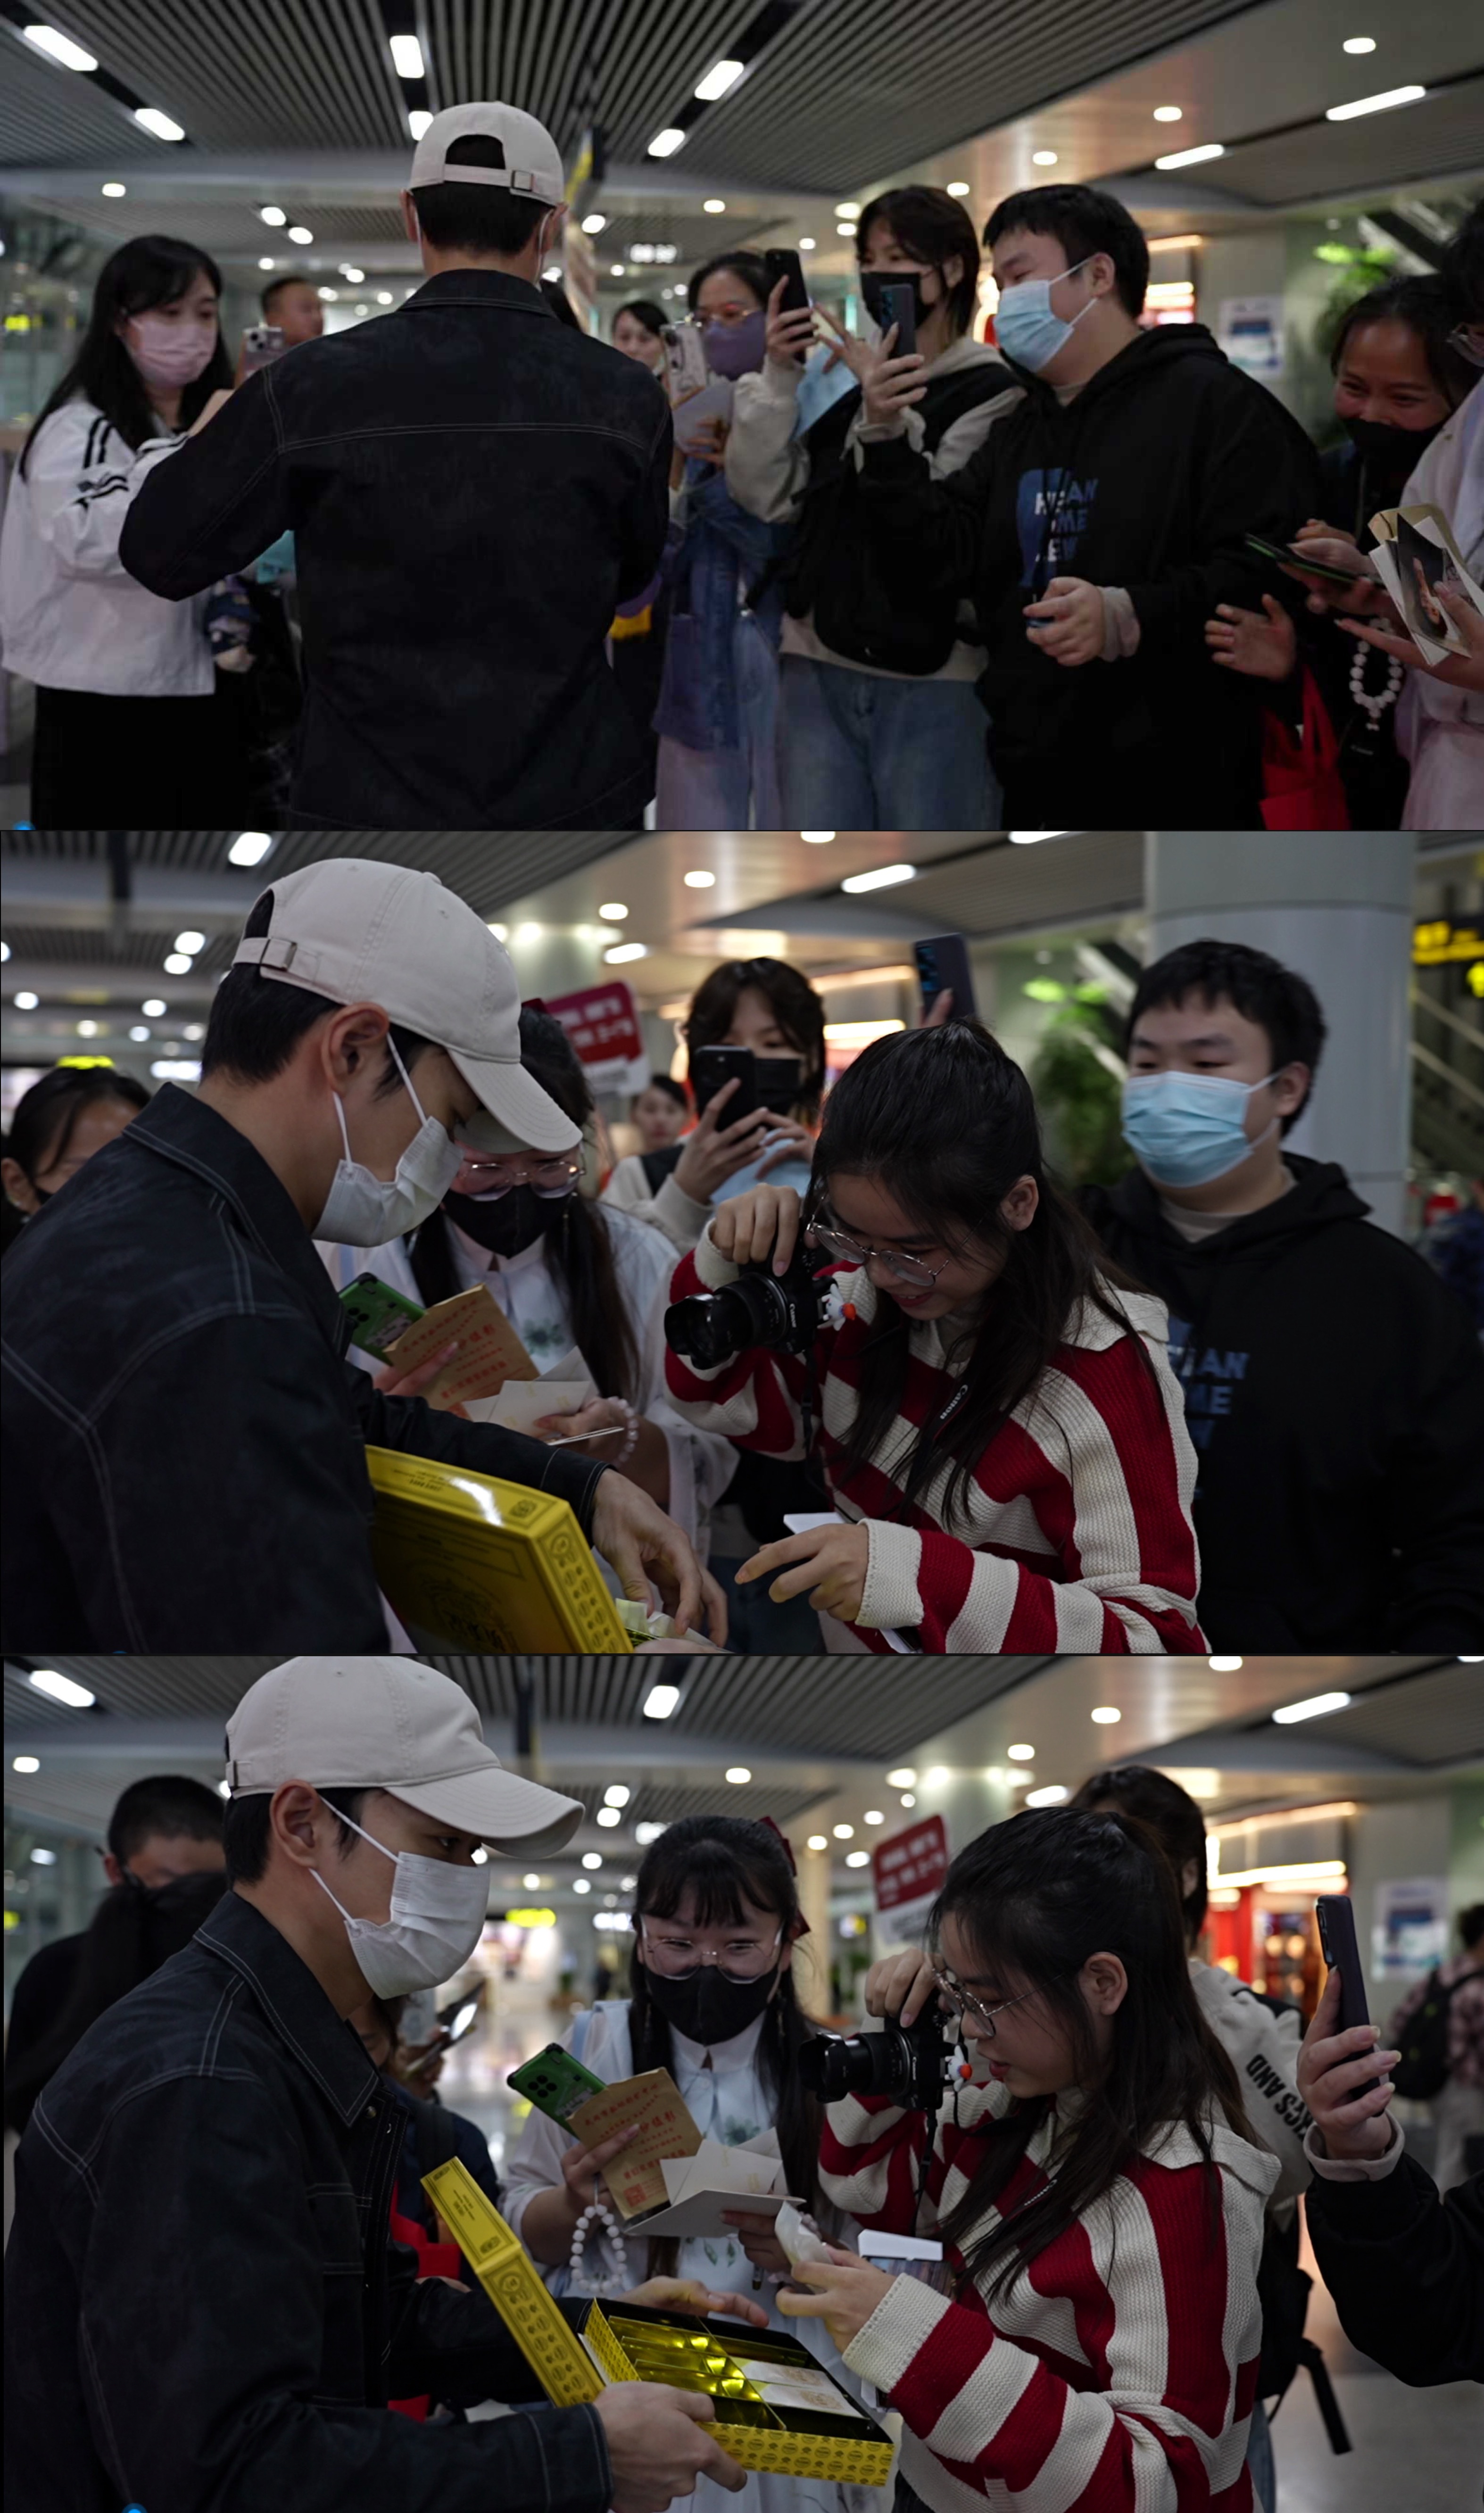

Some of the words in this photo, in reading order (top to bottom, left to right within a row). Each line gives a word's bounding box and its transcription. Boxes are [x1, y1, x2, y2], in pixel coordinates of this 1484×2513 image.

[939, 1384, 969, 1419] Canon
[1246, 2054, 1286, 2099] AND
[1024, 2179, 1058, 2206] Canon
